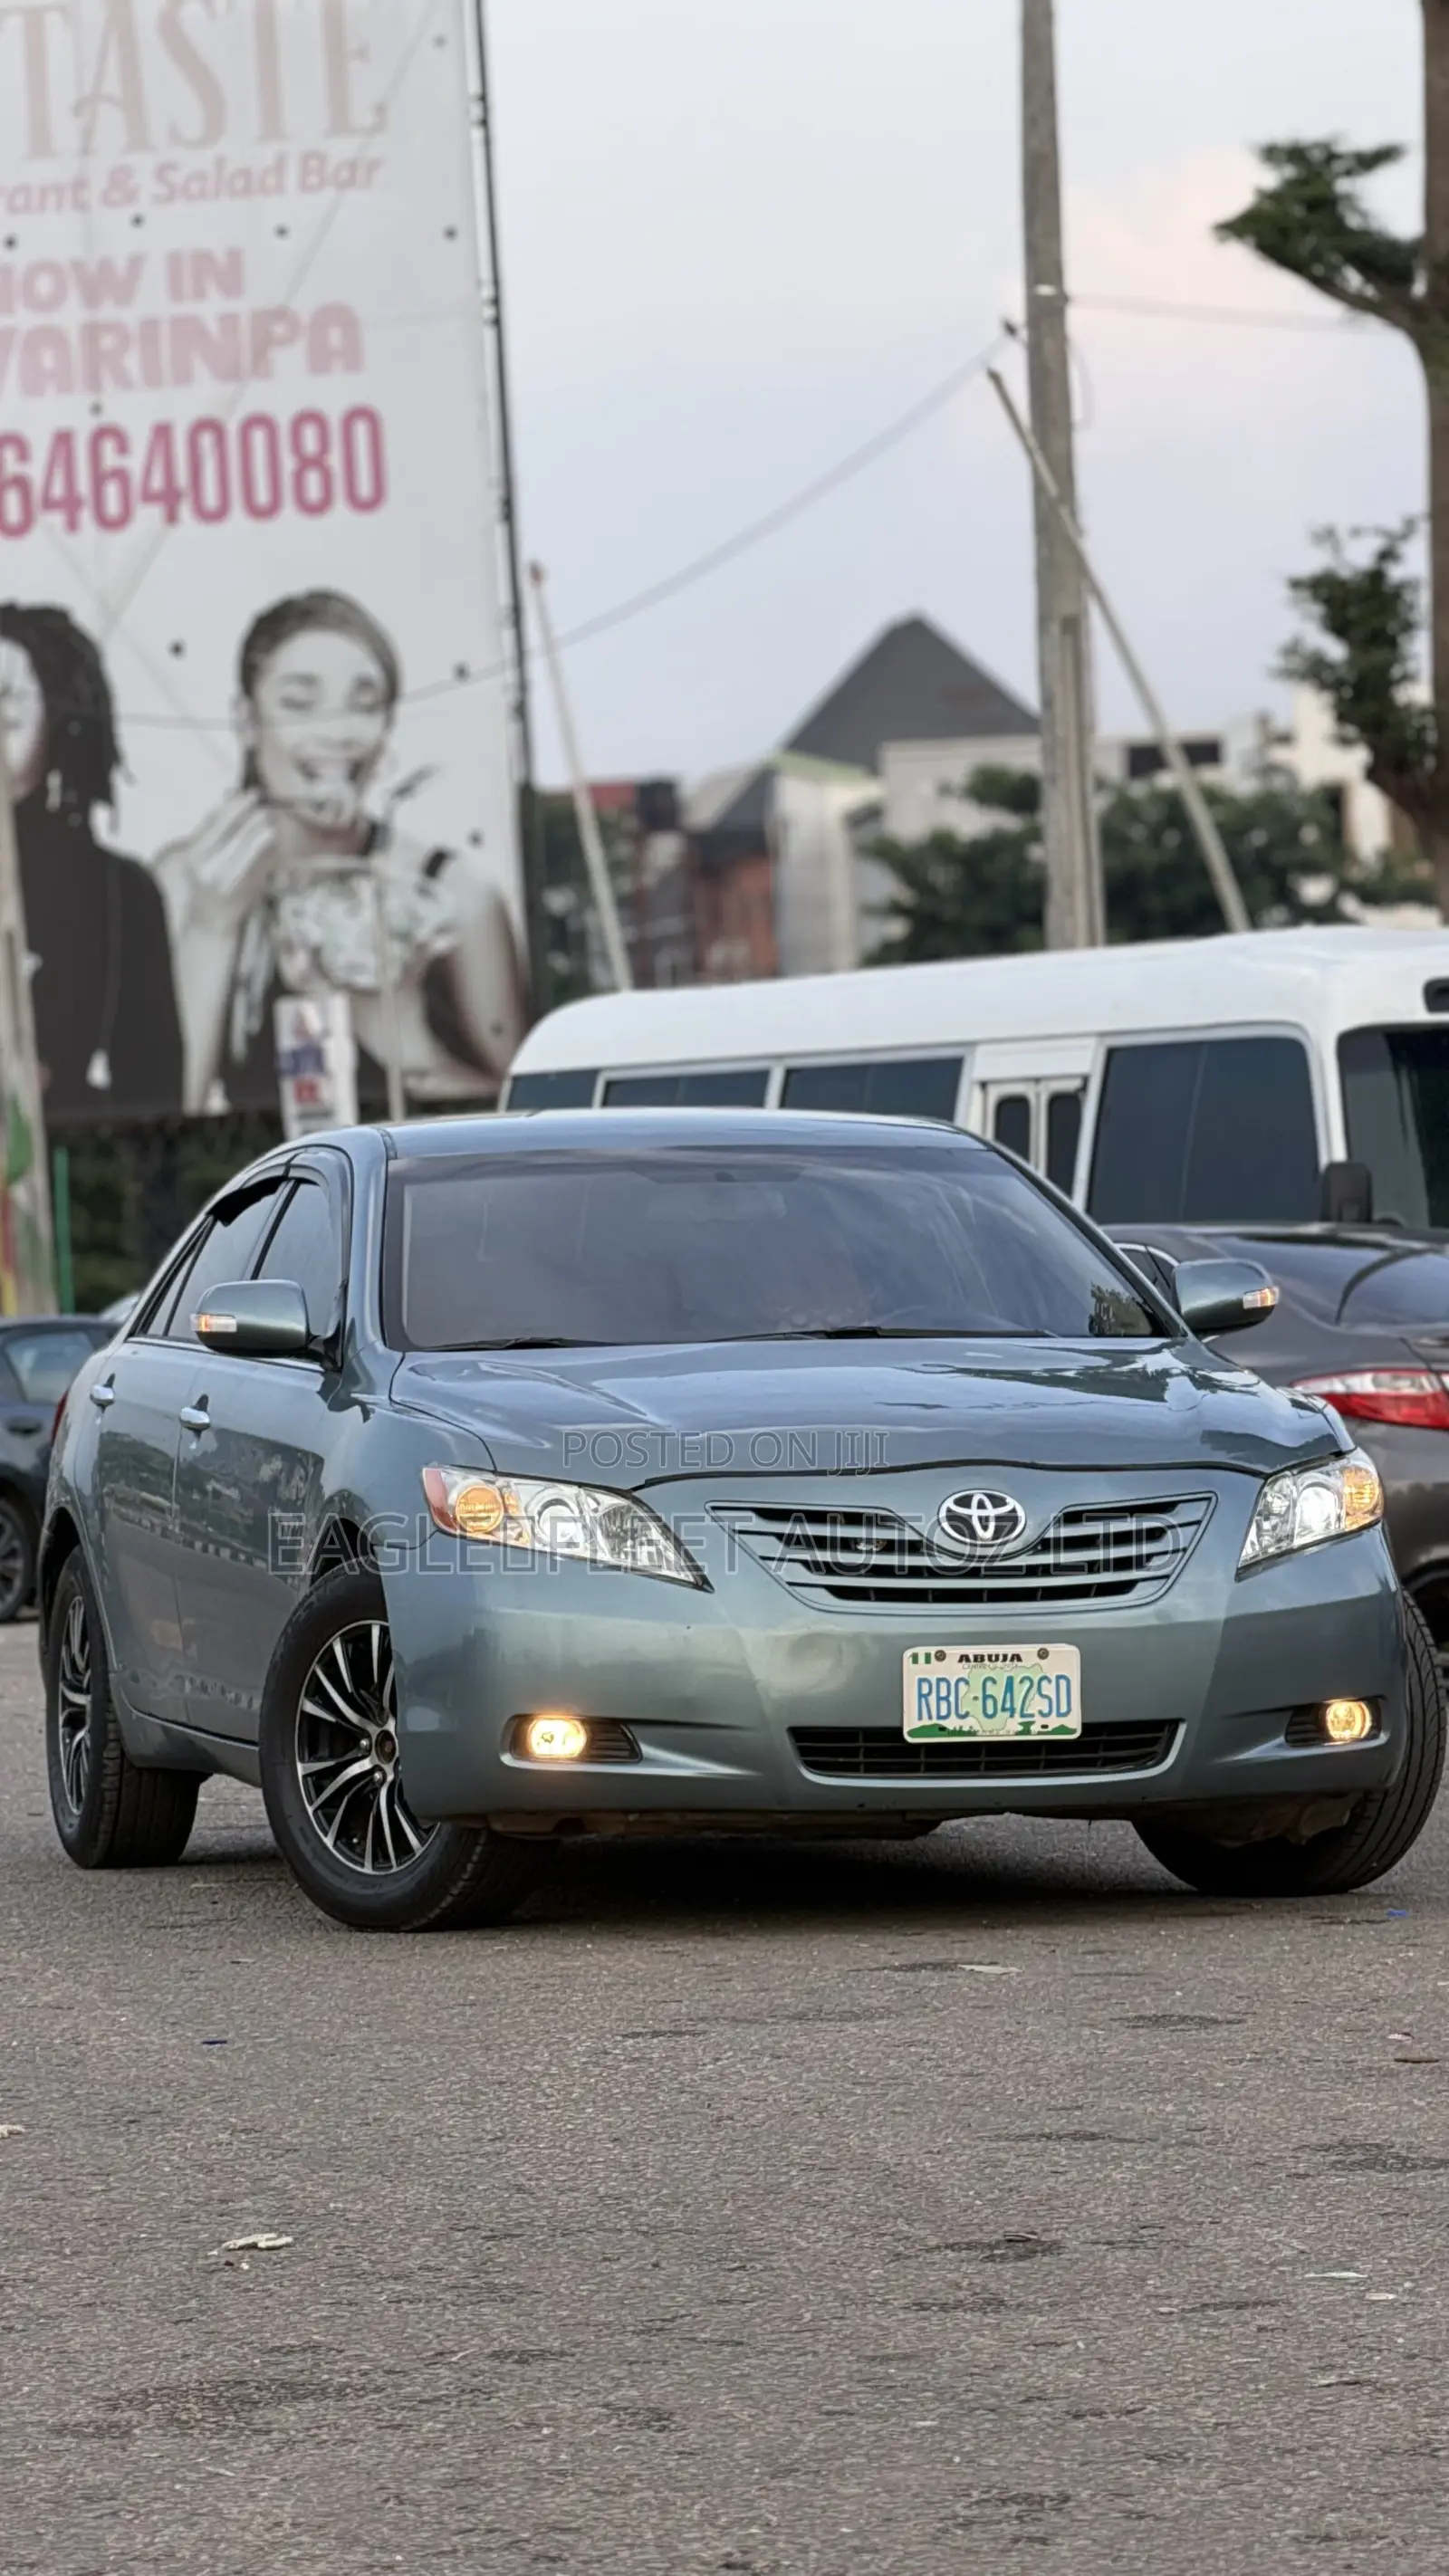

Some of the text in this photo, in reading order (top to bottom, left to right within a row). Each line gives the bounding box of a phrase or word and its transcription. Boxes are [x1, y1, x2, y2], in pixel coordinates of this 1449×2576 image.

[0, 0, 388, 160] TASTE
[0, 150, 386, 215] ant & Salad Bar
[166, 247, 245, 305] IN
[0, 403, 389, 541] 64640080
[957, 1653, 1022, 1663] ABUJA
[917, 1674, 1072, 1720] RBC-642SD
